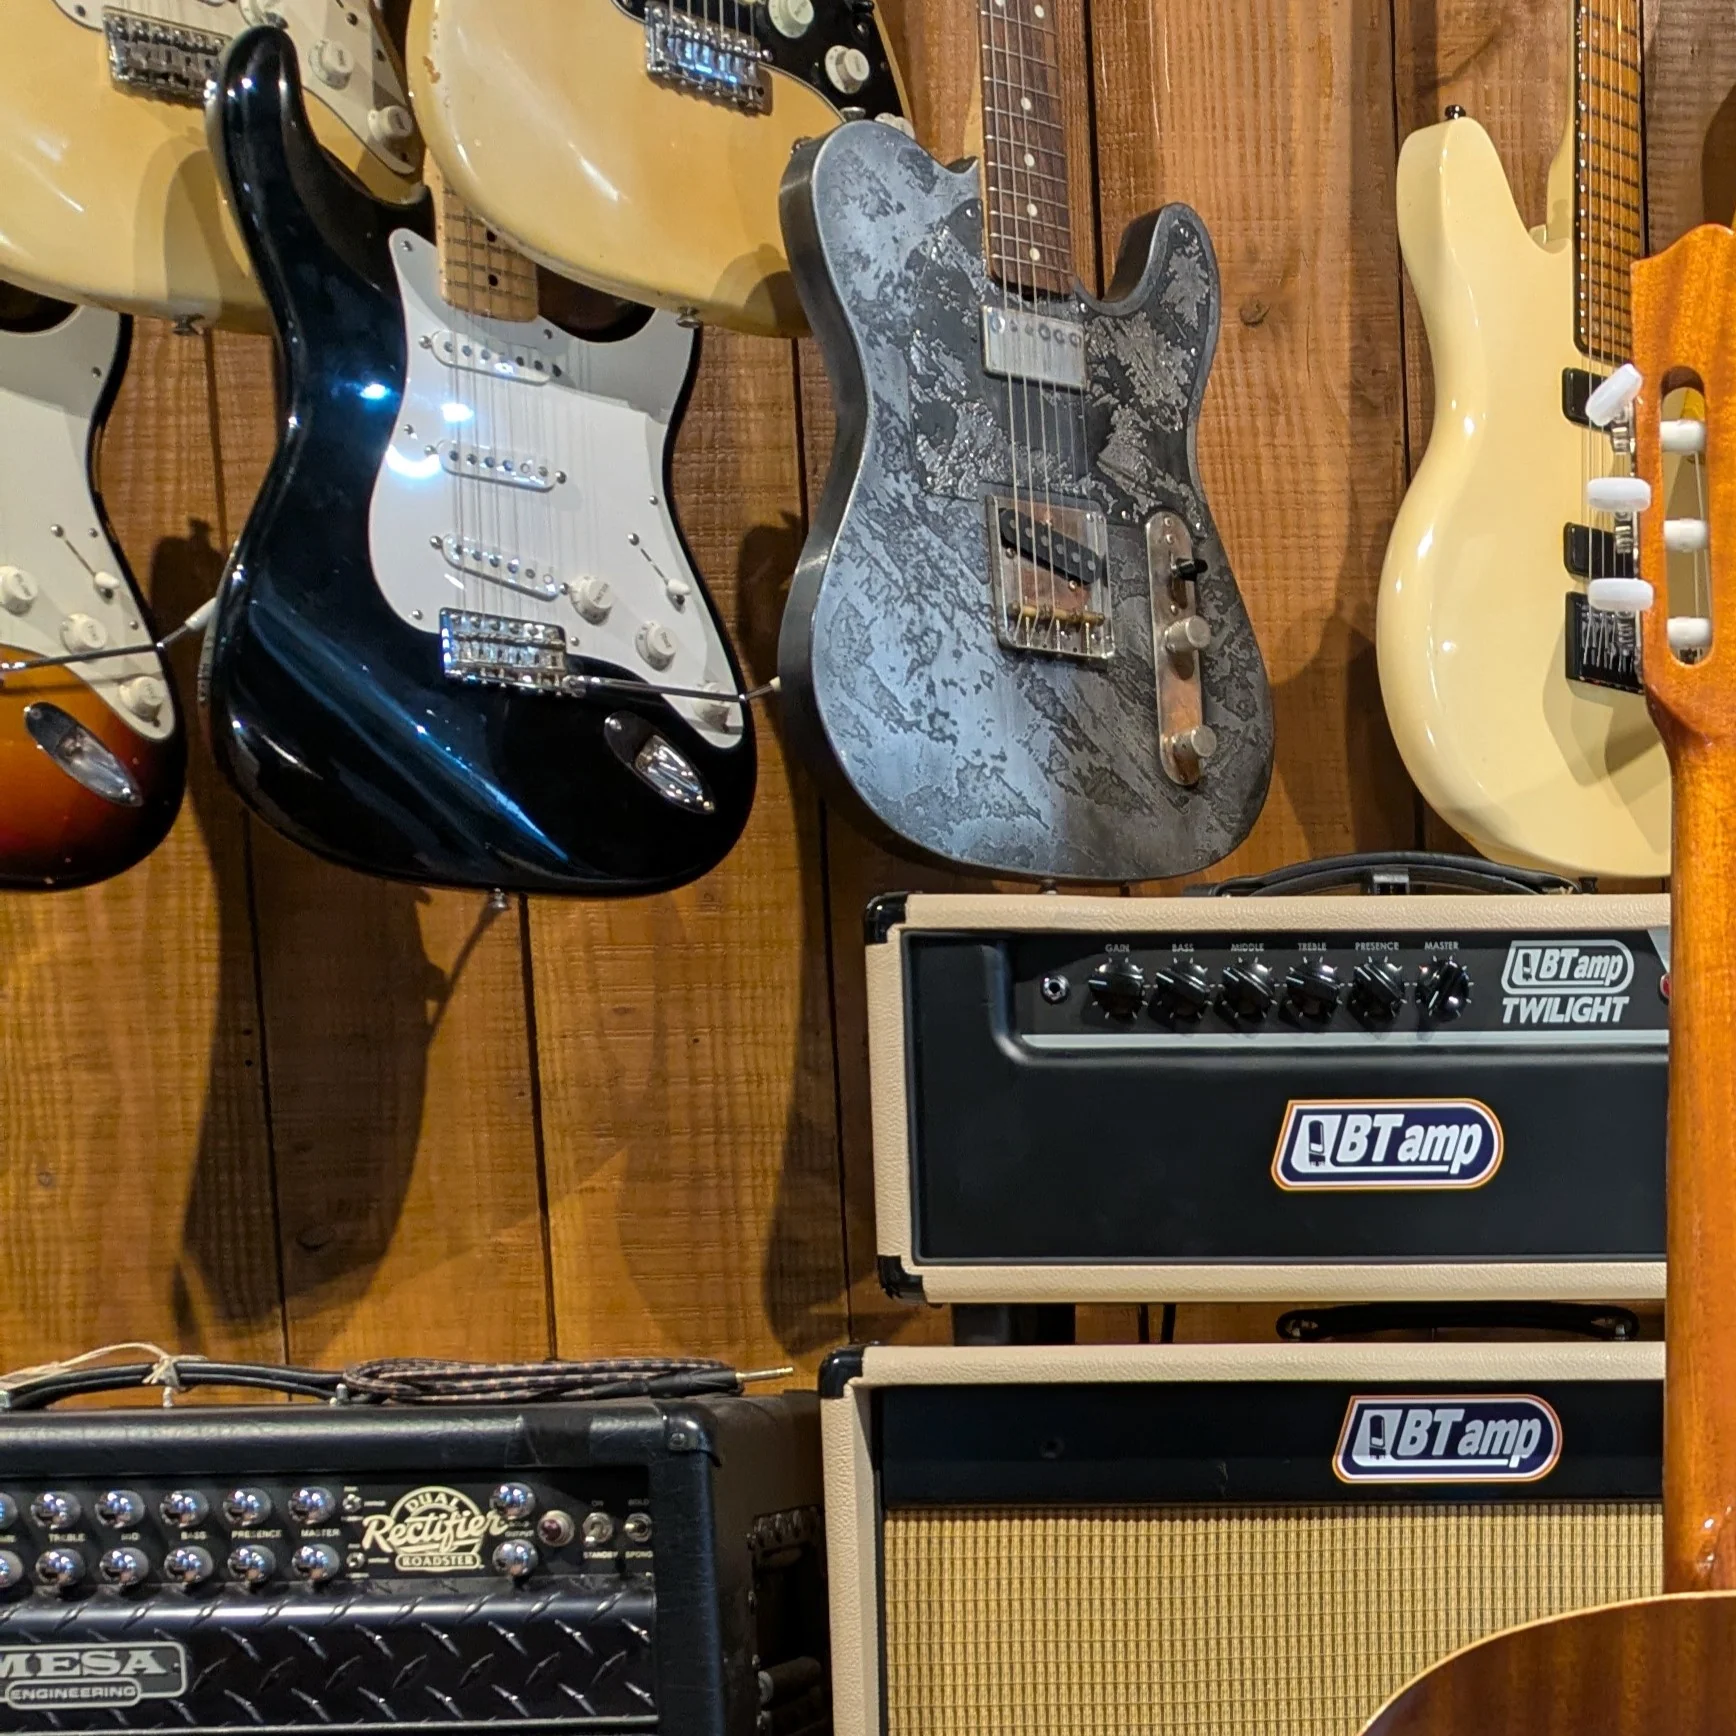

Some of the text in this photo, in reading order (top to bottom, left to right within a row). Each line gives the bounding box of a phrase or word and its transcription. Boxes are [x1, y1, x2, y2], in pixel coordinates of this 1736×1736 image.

[1105, 943, 1130, 953] GAIN
[1171, 943, 1194, 953] BASS
[1231, 942, 1265, 952] MIDDLE
[1297, 942, 1327, 952] TREBLE
[1355, 941, 1400, 951] PRESENCE
[1424, 940, 1460, 951] MASTER
[1502, 995, 1630, 1024] TWILIGHT
[405, 1491, 461, 1516] DUAL
[181, 1531, 207, 1541] BASS
[231, 1529, 282, 1540] PRESENCE
[300, 1528, 341, 1538] MASTER
[361, 1509, 509, 1554] Rectifier
[49, 1533, 86, 1542] TREBLE
[583, 1551, 619, 1559] STANDBY
[401, 1555, 474, 1567] ROADSTER
[10, 1685, 137, 1701] ENGINEERING
